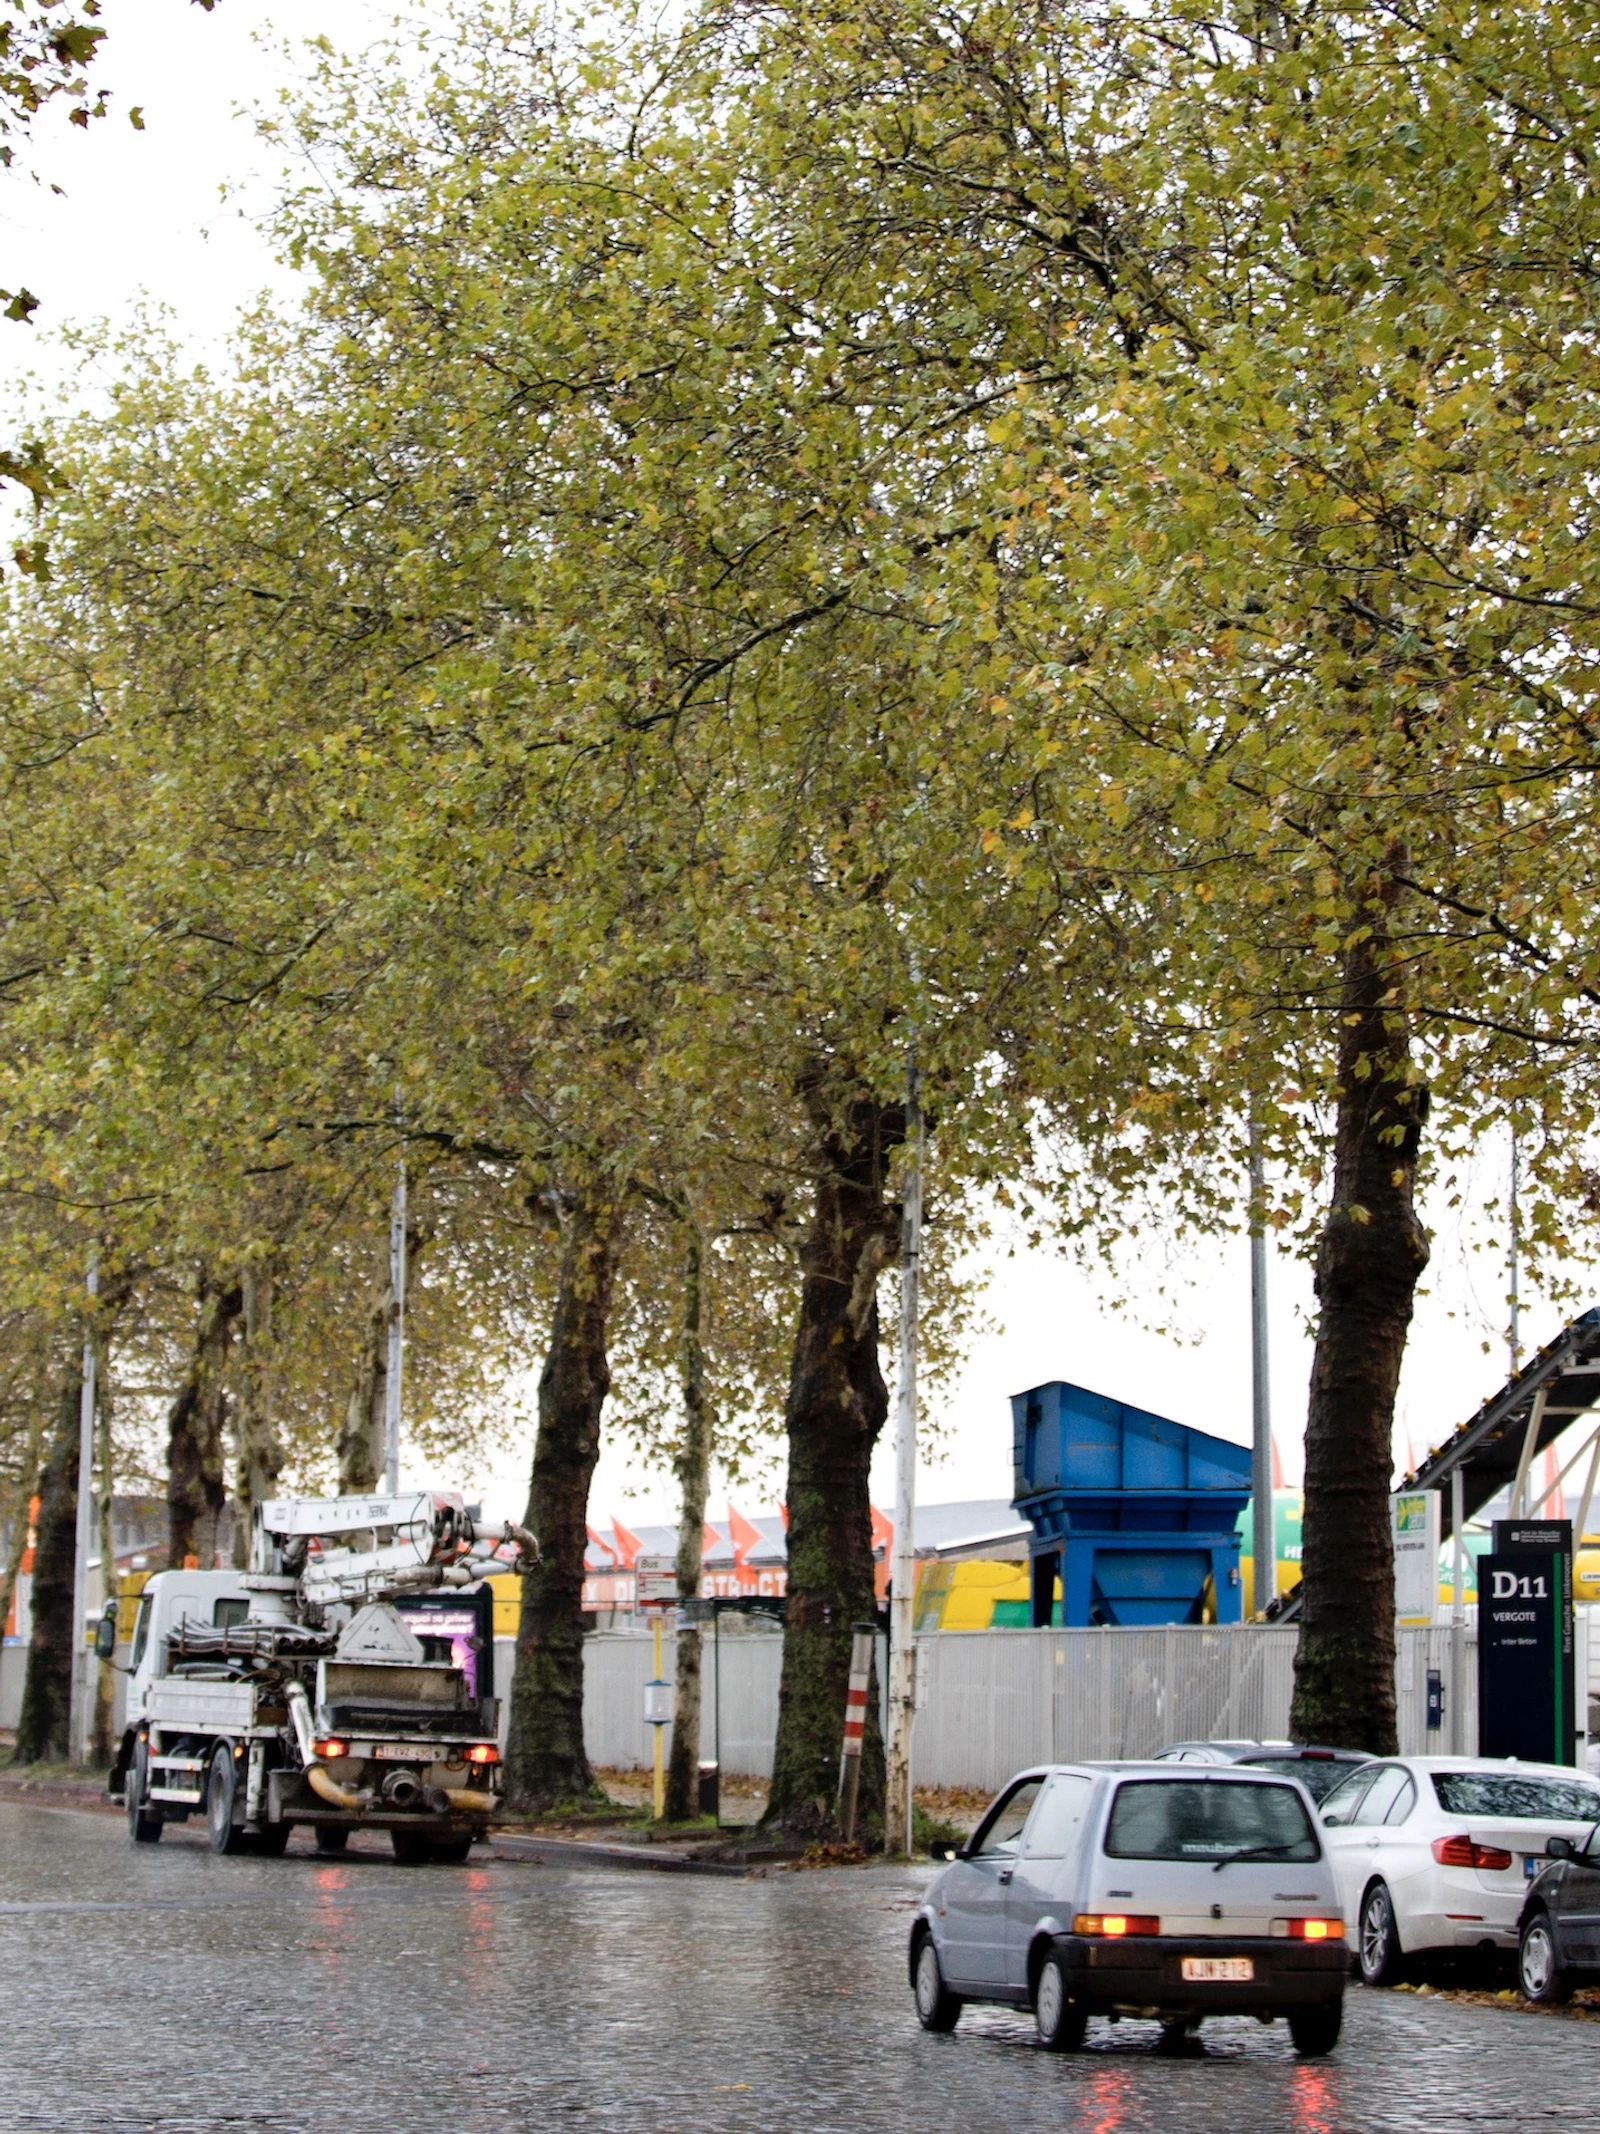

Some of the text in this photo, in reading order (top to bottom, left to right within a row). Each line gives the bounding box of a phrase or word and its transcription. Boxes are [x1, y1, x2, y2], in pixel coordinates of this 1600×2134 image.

[641, 1559, 658, 1568] Bus
[1438, 1572, 1472, 1589] Grop
[1492, 1571, 1549, 1599] D11
[1493, 1611, 1536, 1622] VERGOTE
[1563, 1604, 1571, 1636] Gauche
[1186, 1960, 1249, 1978] AJN-212
